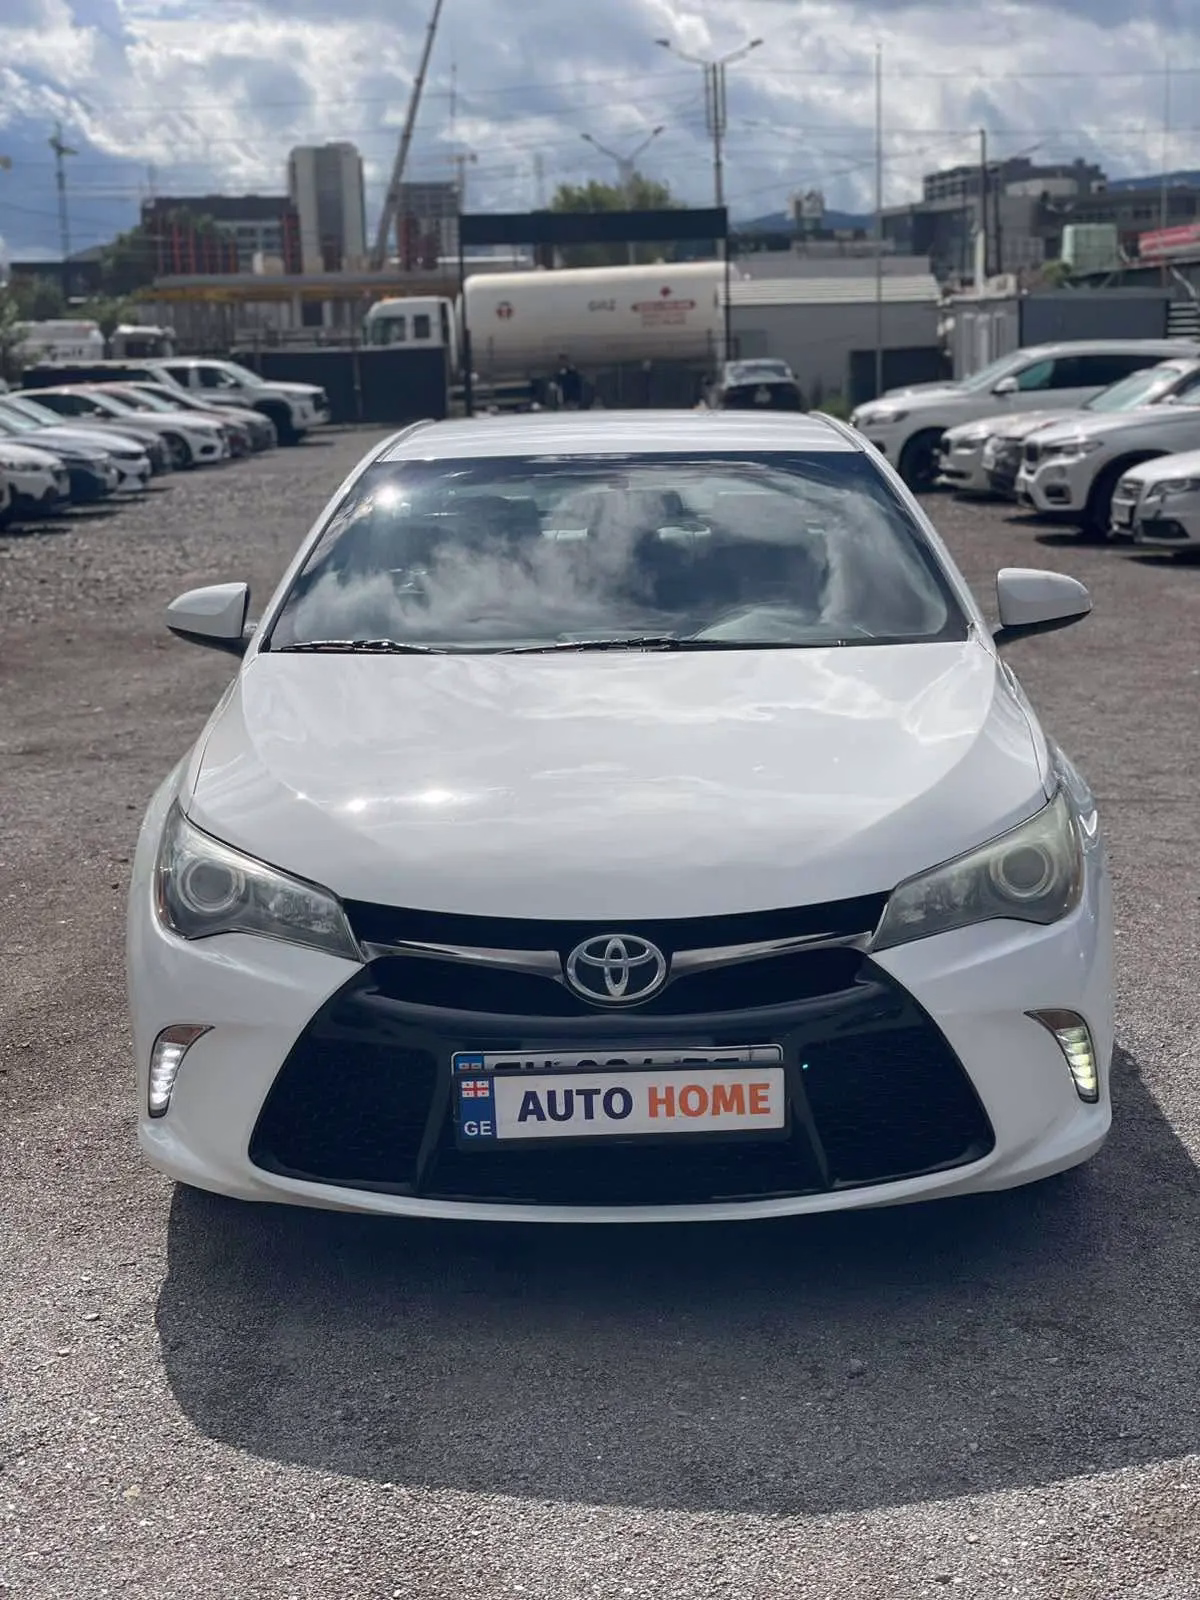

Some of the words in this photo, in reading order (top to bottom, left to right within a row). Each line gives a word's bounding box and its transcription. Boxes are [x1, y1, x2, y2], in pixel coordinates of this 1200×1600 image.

[517, 1086, 634, 1122] AUTO
[648, 1083, 771, 1118] HOME
[464, 1121, 492, 1136] GE
